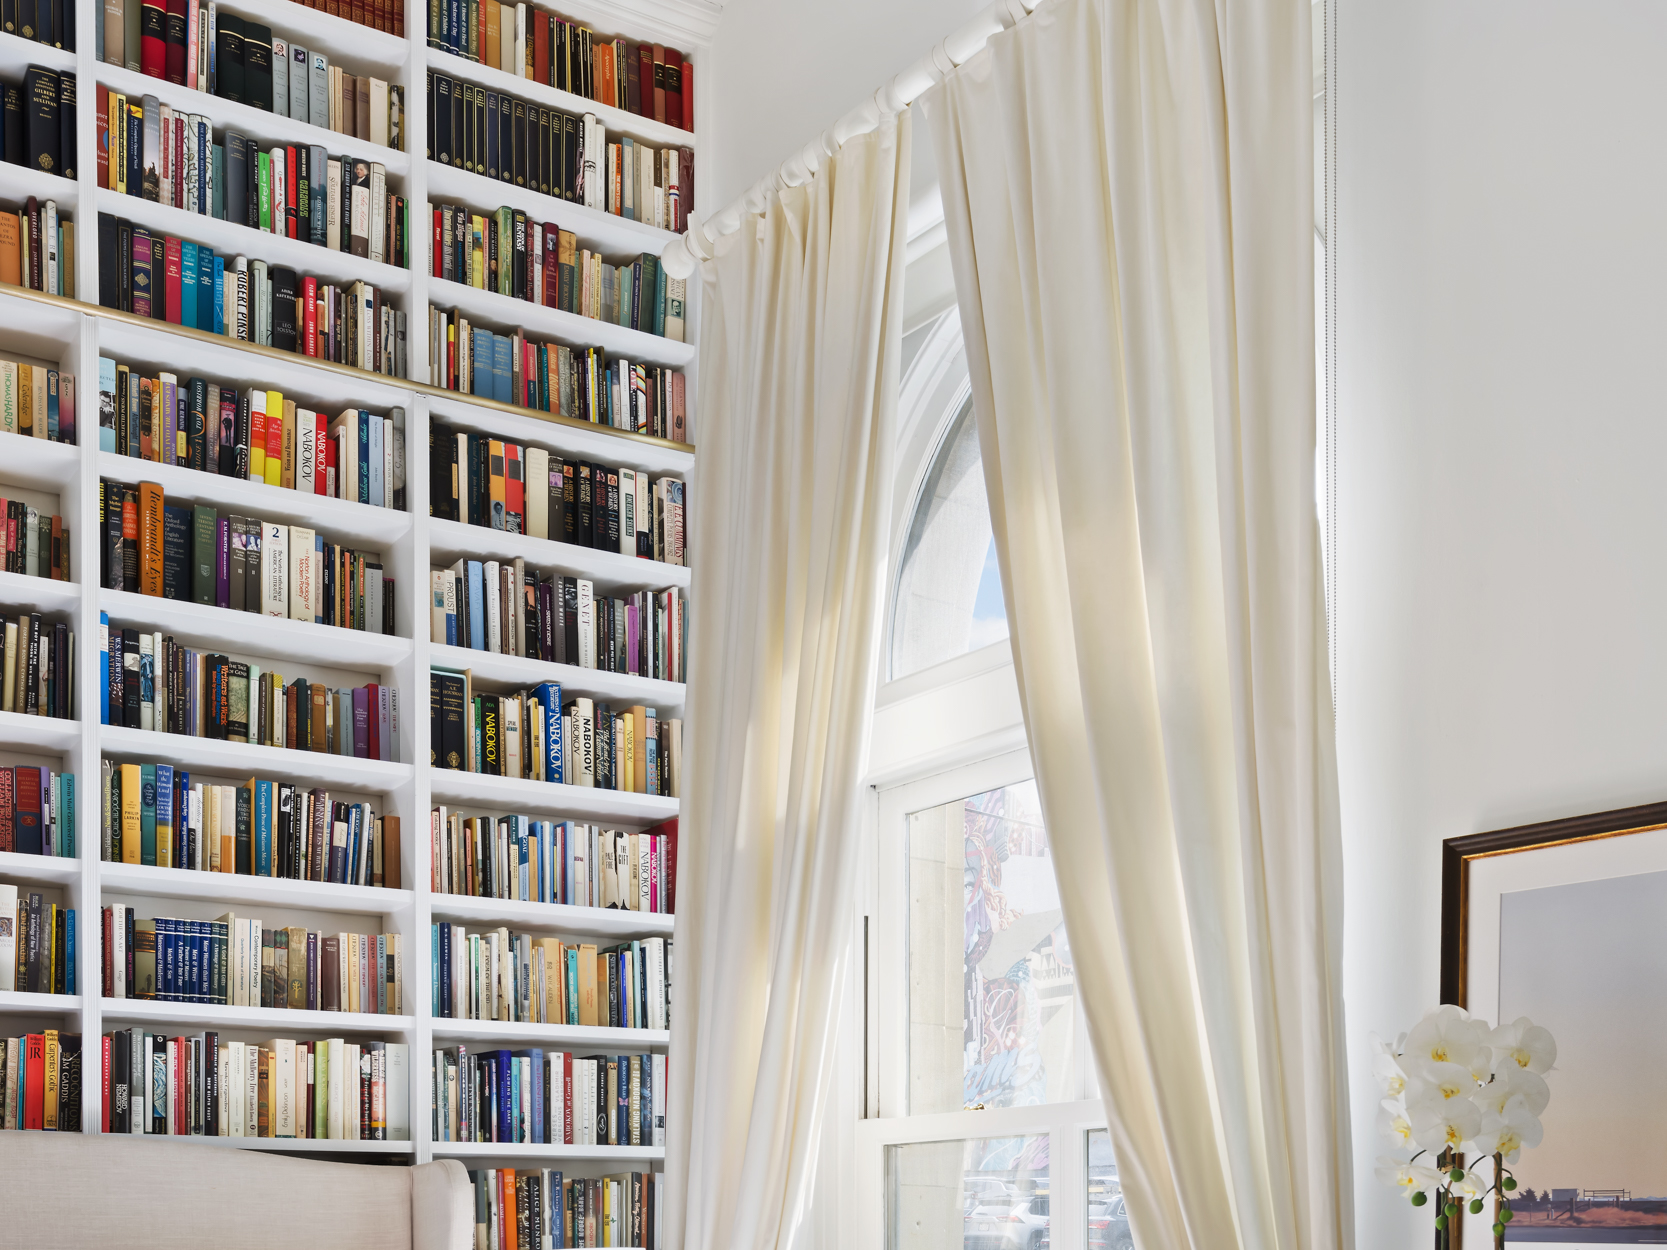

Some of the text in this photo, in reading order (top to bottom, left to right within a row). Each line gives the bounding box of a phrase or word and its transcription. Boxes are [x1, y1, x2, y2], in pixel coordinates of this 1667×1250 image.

[33, 97, 57, 107] SULLIVAN
[35, 88, 55, 97] GILBERT
[238, 270, 247, 341] ROBERT PINSK
[5, 399, 13, 428] HARDY
[21, 384, 29, 415] Coleridge
[302, 428, 312, 483] NABOKOV
[317, 431, 326, 473] NABOKOV
[146, 490, 161, 593] Rembrandt's Eyes
[272, 527, 280, 538] 2
[675, 520, 683, 558] CUMMINGS
[581, 584, 590, 626] GENET
[222, 697, 228, 705] at
[486, 712, 496, 764] NABOKOV
[550, 712, 561, 772] NABOKOV
[641, 851, 649, 900] NABOKOV
[30, 1047, 41, 1059] JR
[48, 1043, 57, 1092] Carpenter's Gothic
[61, 1072, 69, 1102] GADDIS
[70, 1059, 80, 1130] RECOGNITIONS
[282, 1115, 290, 1128] Emily
